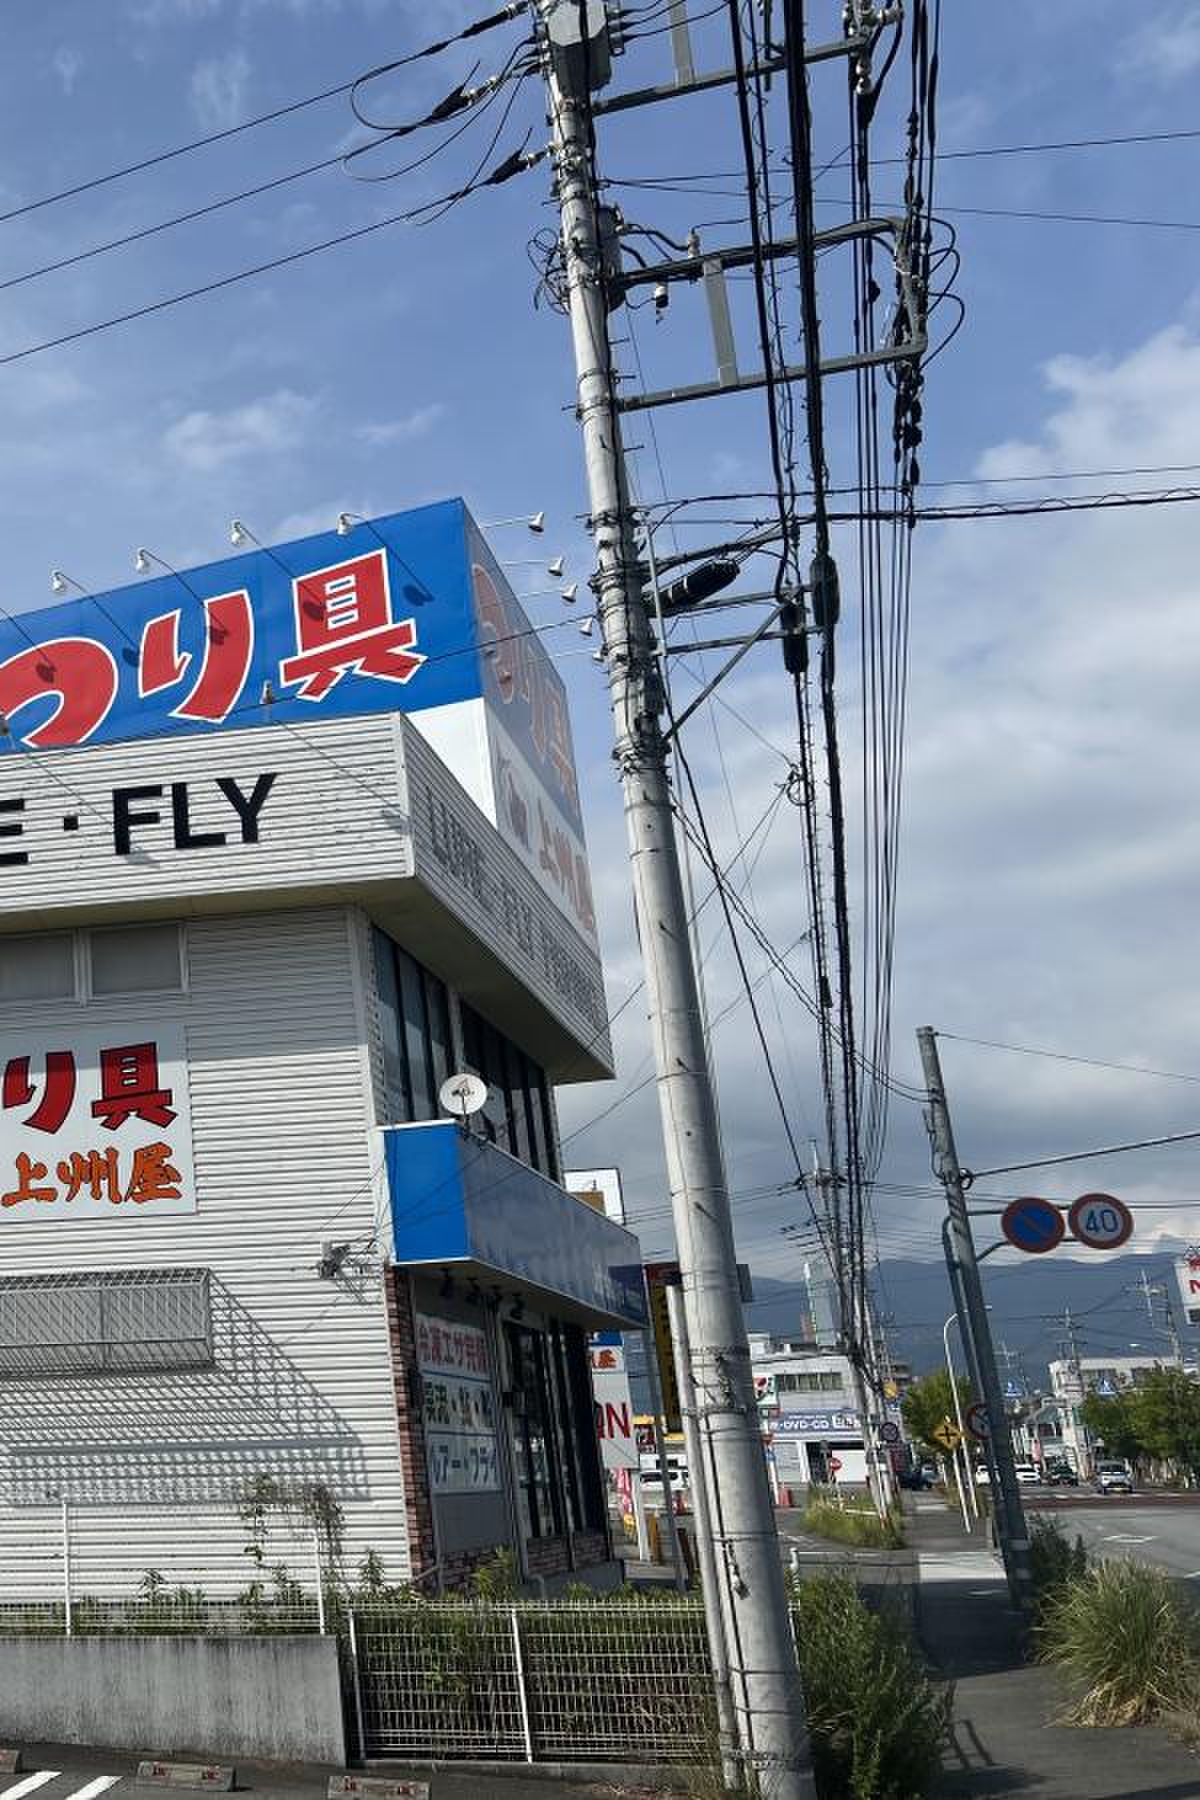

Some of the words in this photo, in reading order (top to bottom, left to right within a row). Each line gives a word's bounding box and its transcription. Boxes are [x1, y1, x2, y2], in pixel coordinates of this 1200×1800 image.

[112, 773, 277, 856] FLY
[0, 1141, 183, 1208] 上州屋
[1086, 1209, 1118, 1232] 40
